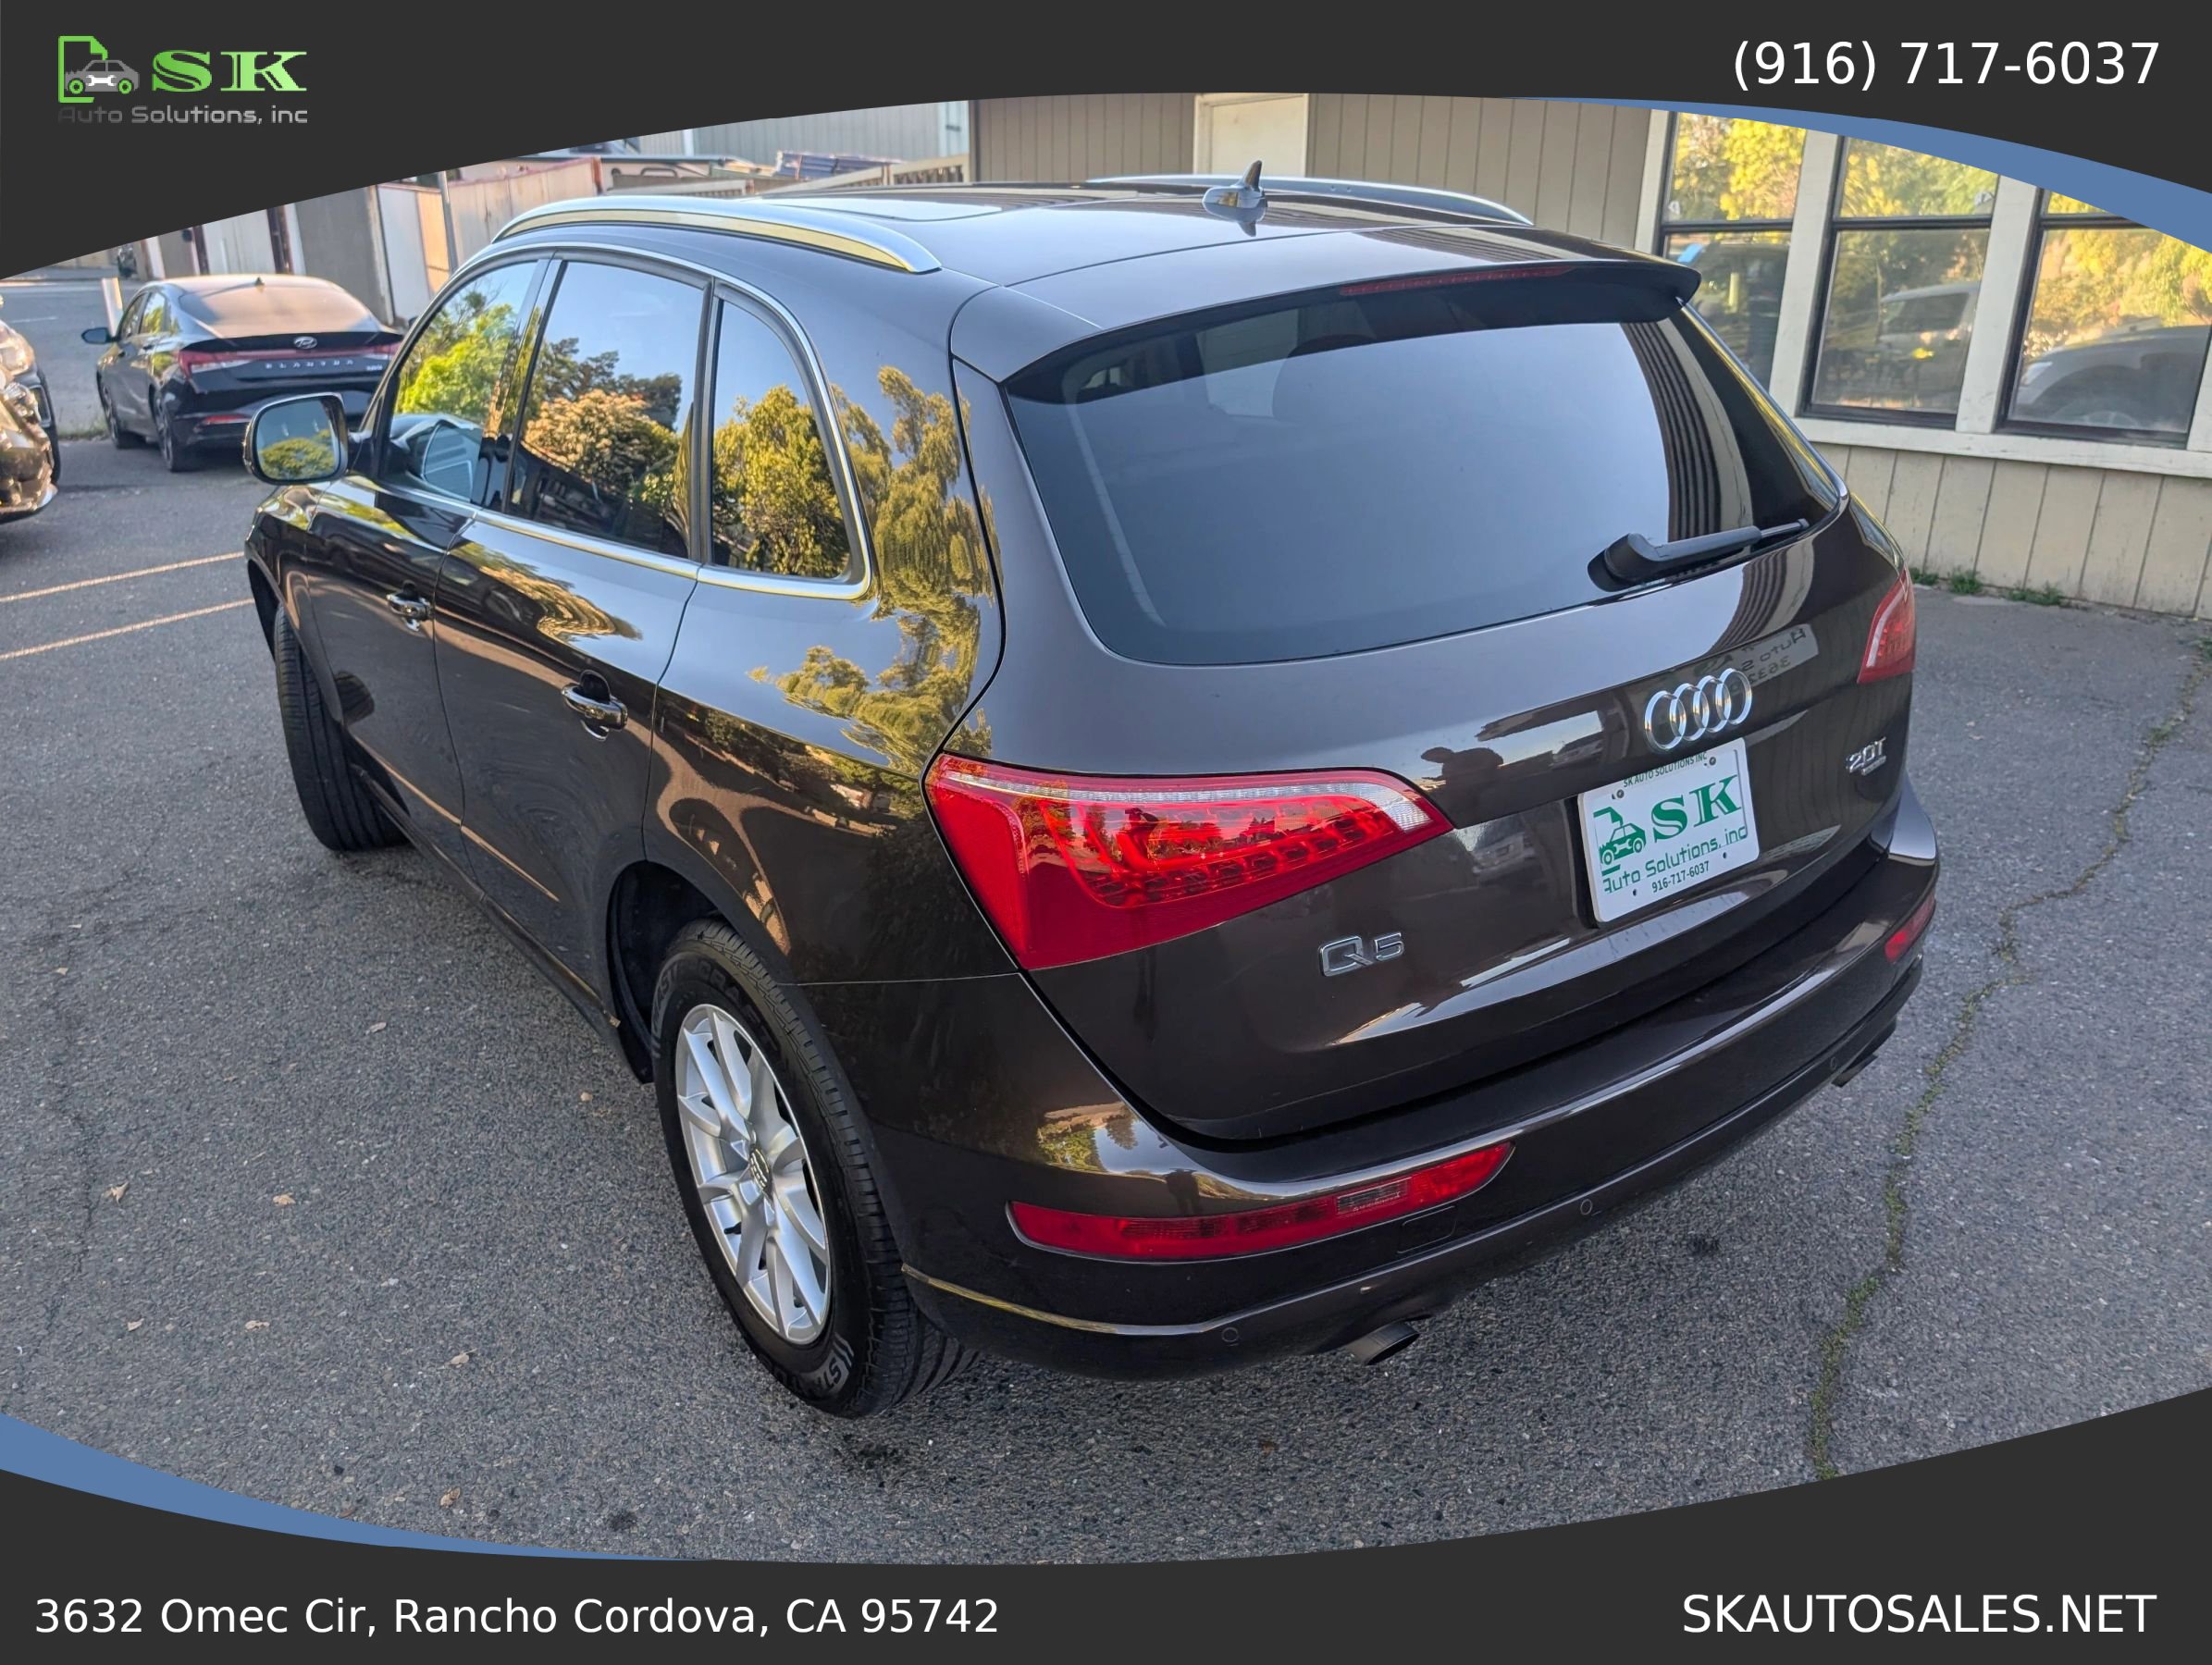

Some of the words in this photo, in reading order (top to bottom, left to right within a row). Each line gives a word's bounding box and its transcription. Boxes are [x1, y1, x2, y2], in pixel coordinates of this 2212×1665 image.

[1634, 771, 1653, 784] AUTO
[1655, 758, 1695, 777] SOLUTIONS
[1650, 774, 1742, 843] SK
[1603, 870, 1641, 894] Auto
[1651, 860, 1710, 894] 916-717-6037
